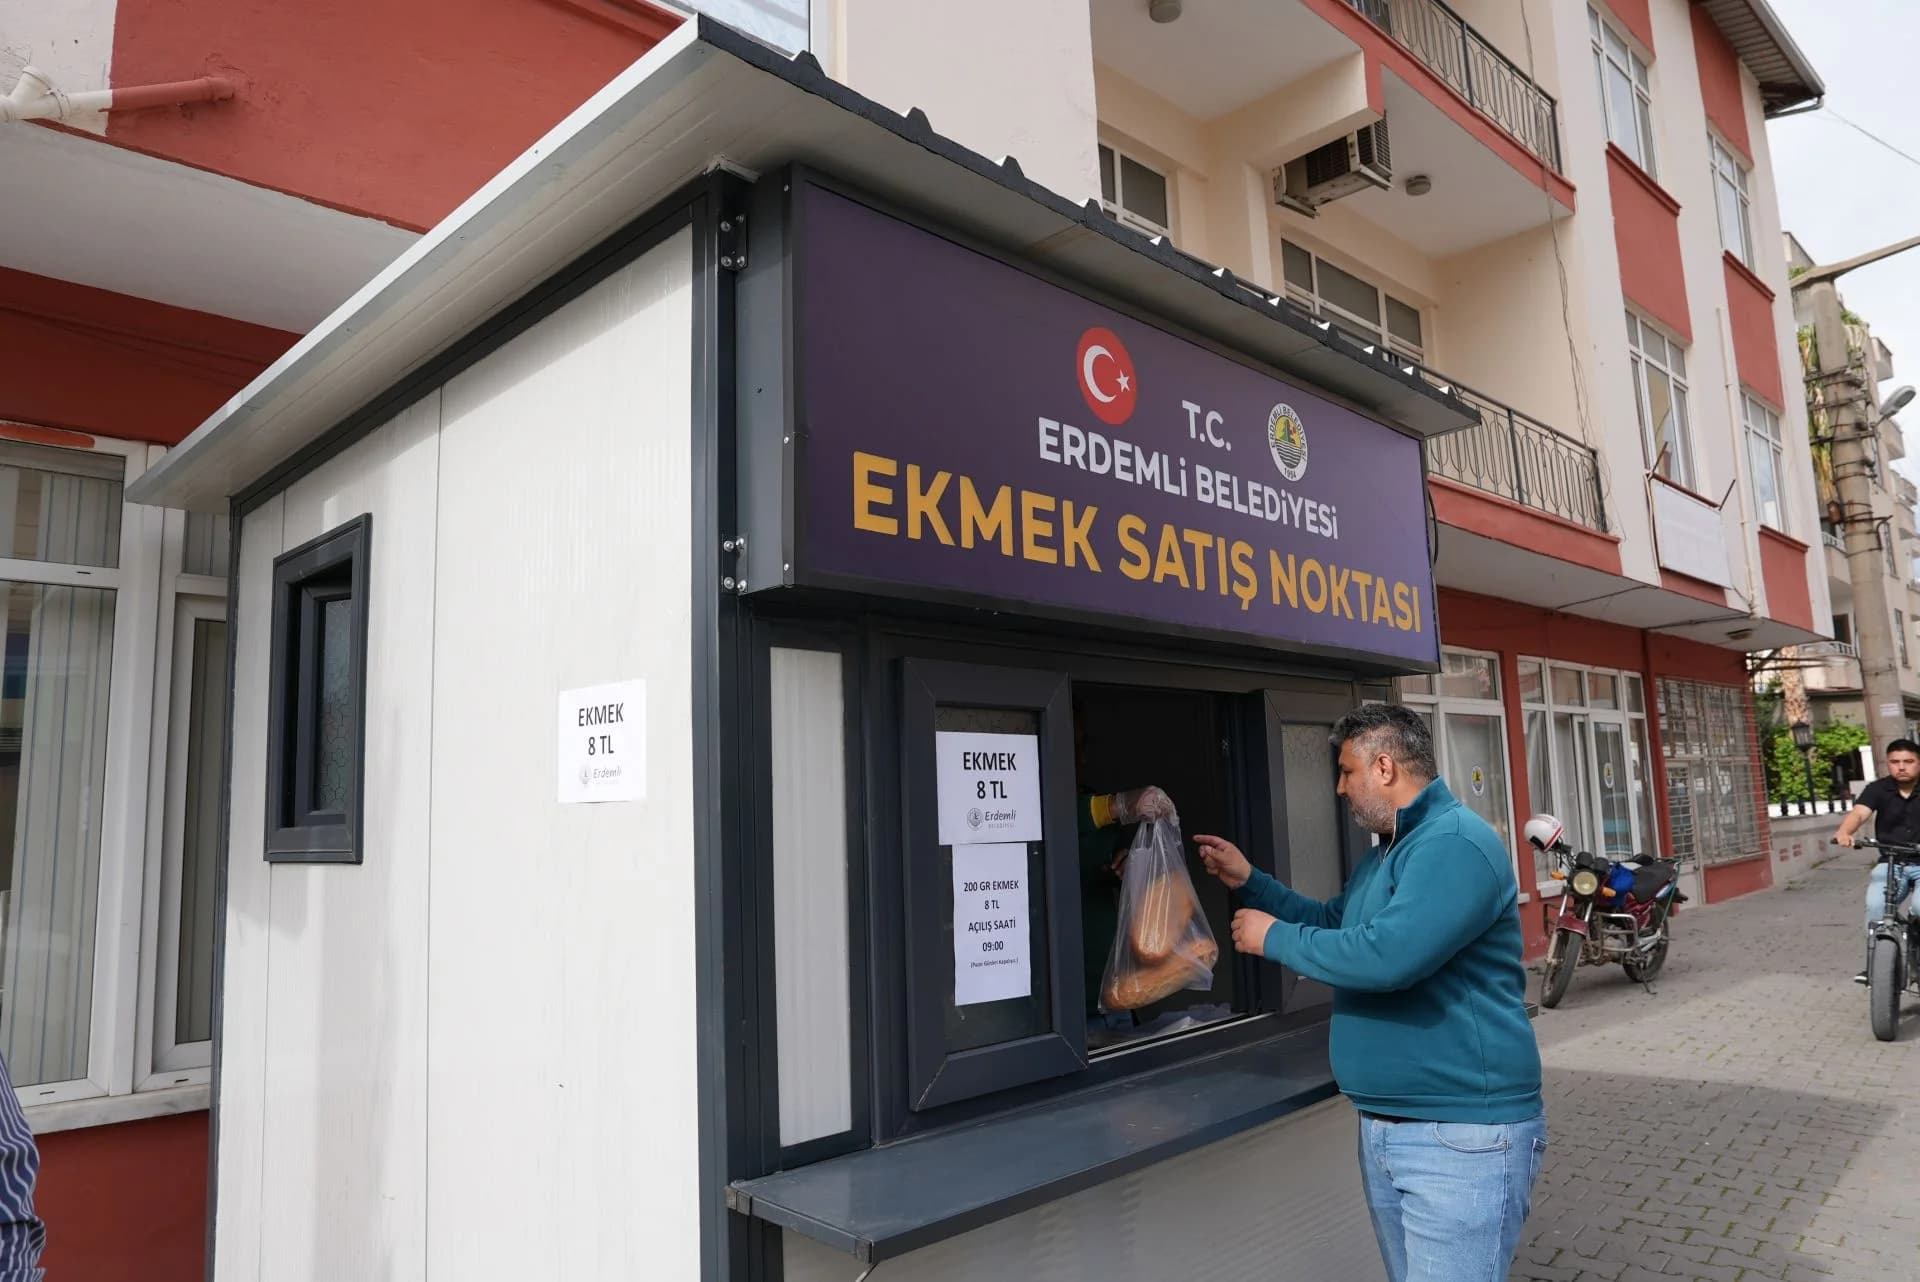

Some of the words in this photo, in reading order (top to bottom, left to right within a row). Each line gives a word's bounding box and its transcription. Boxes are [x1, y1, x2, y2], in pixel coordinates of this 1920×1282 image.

[1181, 399, 1232, 451] T.C.
[853, 450, 1101, 572] EKMEK
[1118, 514, 1258, 609] SATIŞ
[1270, 552, 1421, 631] NOKTASI
[578, 702, 624, 727] EKMEK
[588, 736, 596, 756] 8
[599, 735, 615, 755] TL
[963, 751, 1017, 771] EKMEK
[976, 780, 986, 800] 8
[989, 780, 1008, 799] TL
[984, 808, 1017, 822] Erdemli
[964, 881, 978, 892] 200
[980, 880, 991, 891] GR
[992, 879, 1019, 891] EKMEK
[984, 900, 990, 910] 8
[991, 899, 1000, 910] TL
[968, 920, 993, 934] AÇILIŞ
[994, 916, 1016, 931] SAATİ
[982, 941, 1004, 952] 09:00
